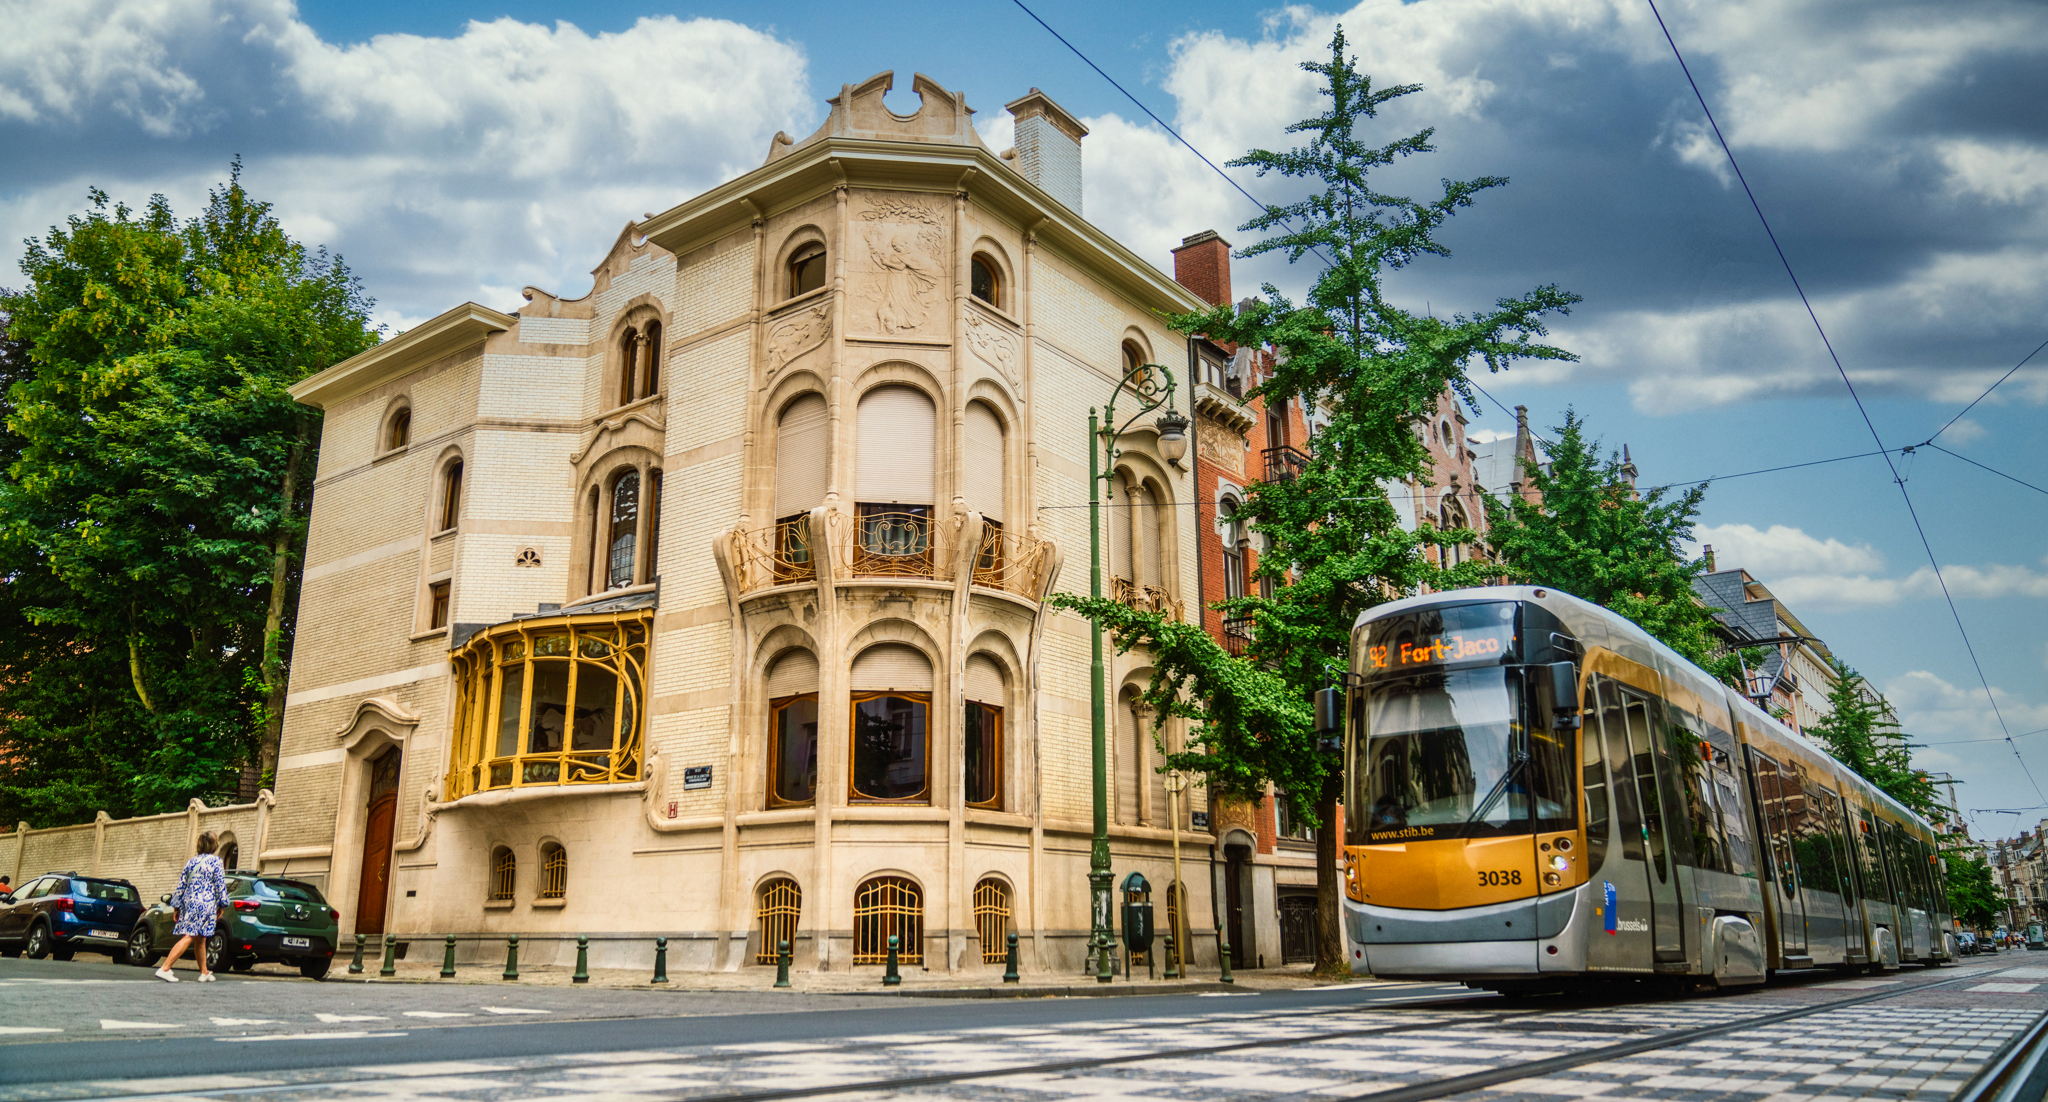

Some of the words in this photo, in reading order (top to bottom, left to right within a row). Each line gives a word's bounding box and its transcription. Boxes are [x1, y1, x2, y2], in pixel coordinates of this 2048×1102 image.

[1369, 645, 1388, 668] 92
[1400, 635, 1500, 664] Fort-Jaco
[1371, 825, 1435, 840] www.stib.be
[1477, 870, 1522, 887] 3038
